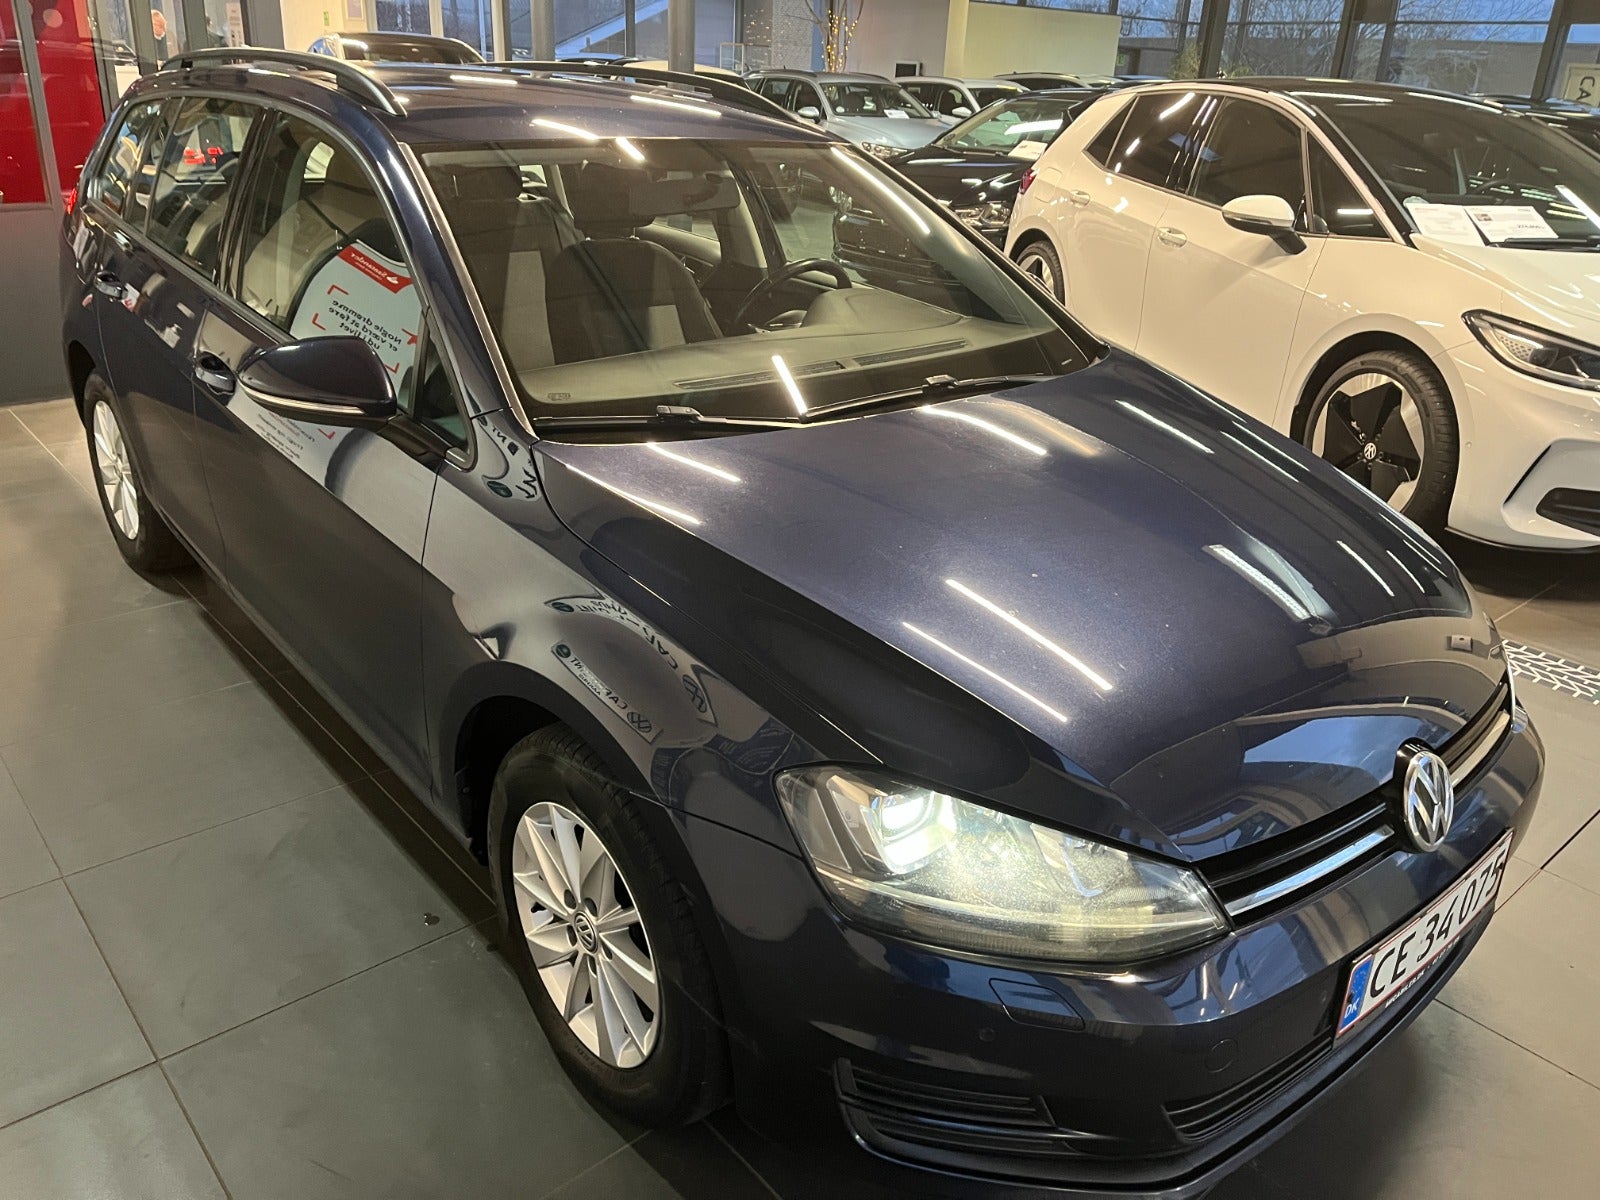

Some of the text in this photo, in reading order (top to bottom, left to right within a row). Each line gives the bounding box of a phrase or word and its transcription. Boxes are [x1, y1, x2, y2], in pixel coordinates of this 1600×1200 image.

[1370, 931, 1416, 998] CE
[1416, 894, 1460, 962] 34
[1458, 848, 1506, 918] 075
[1344, 997, 1360, 1019] DK
